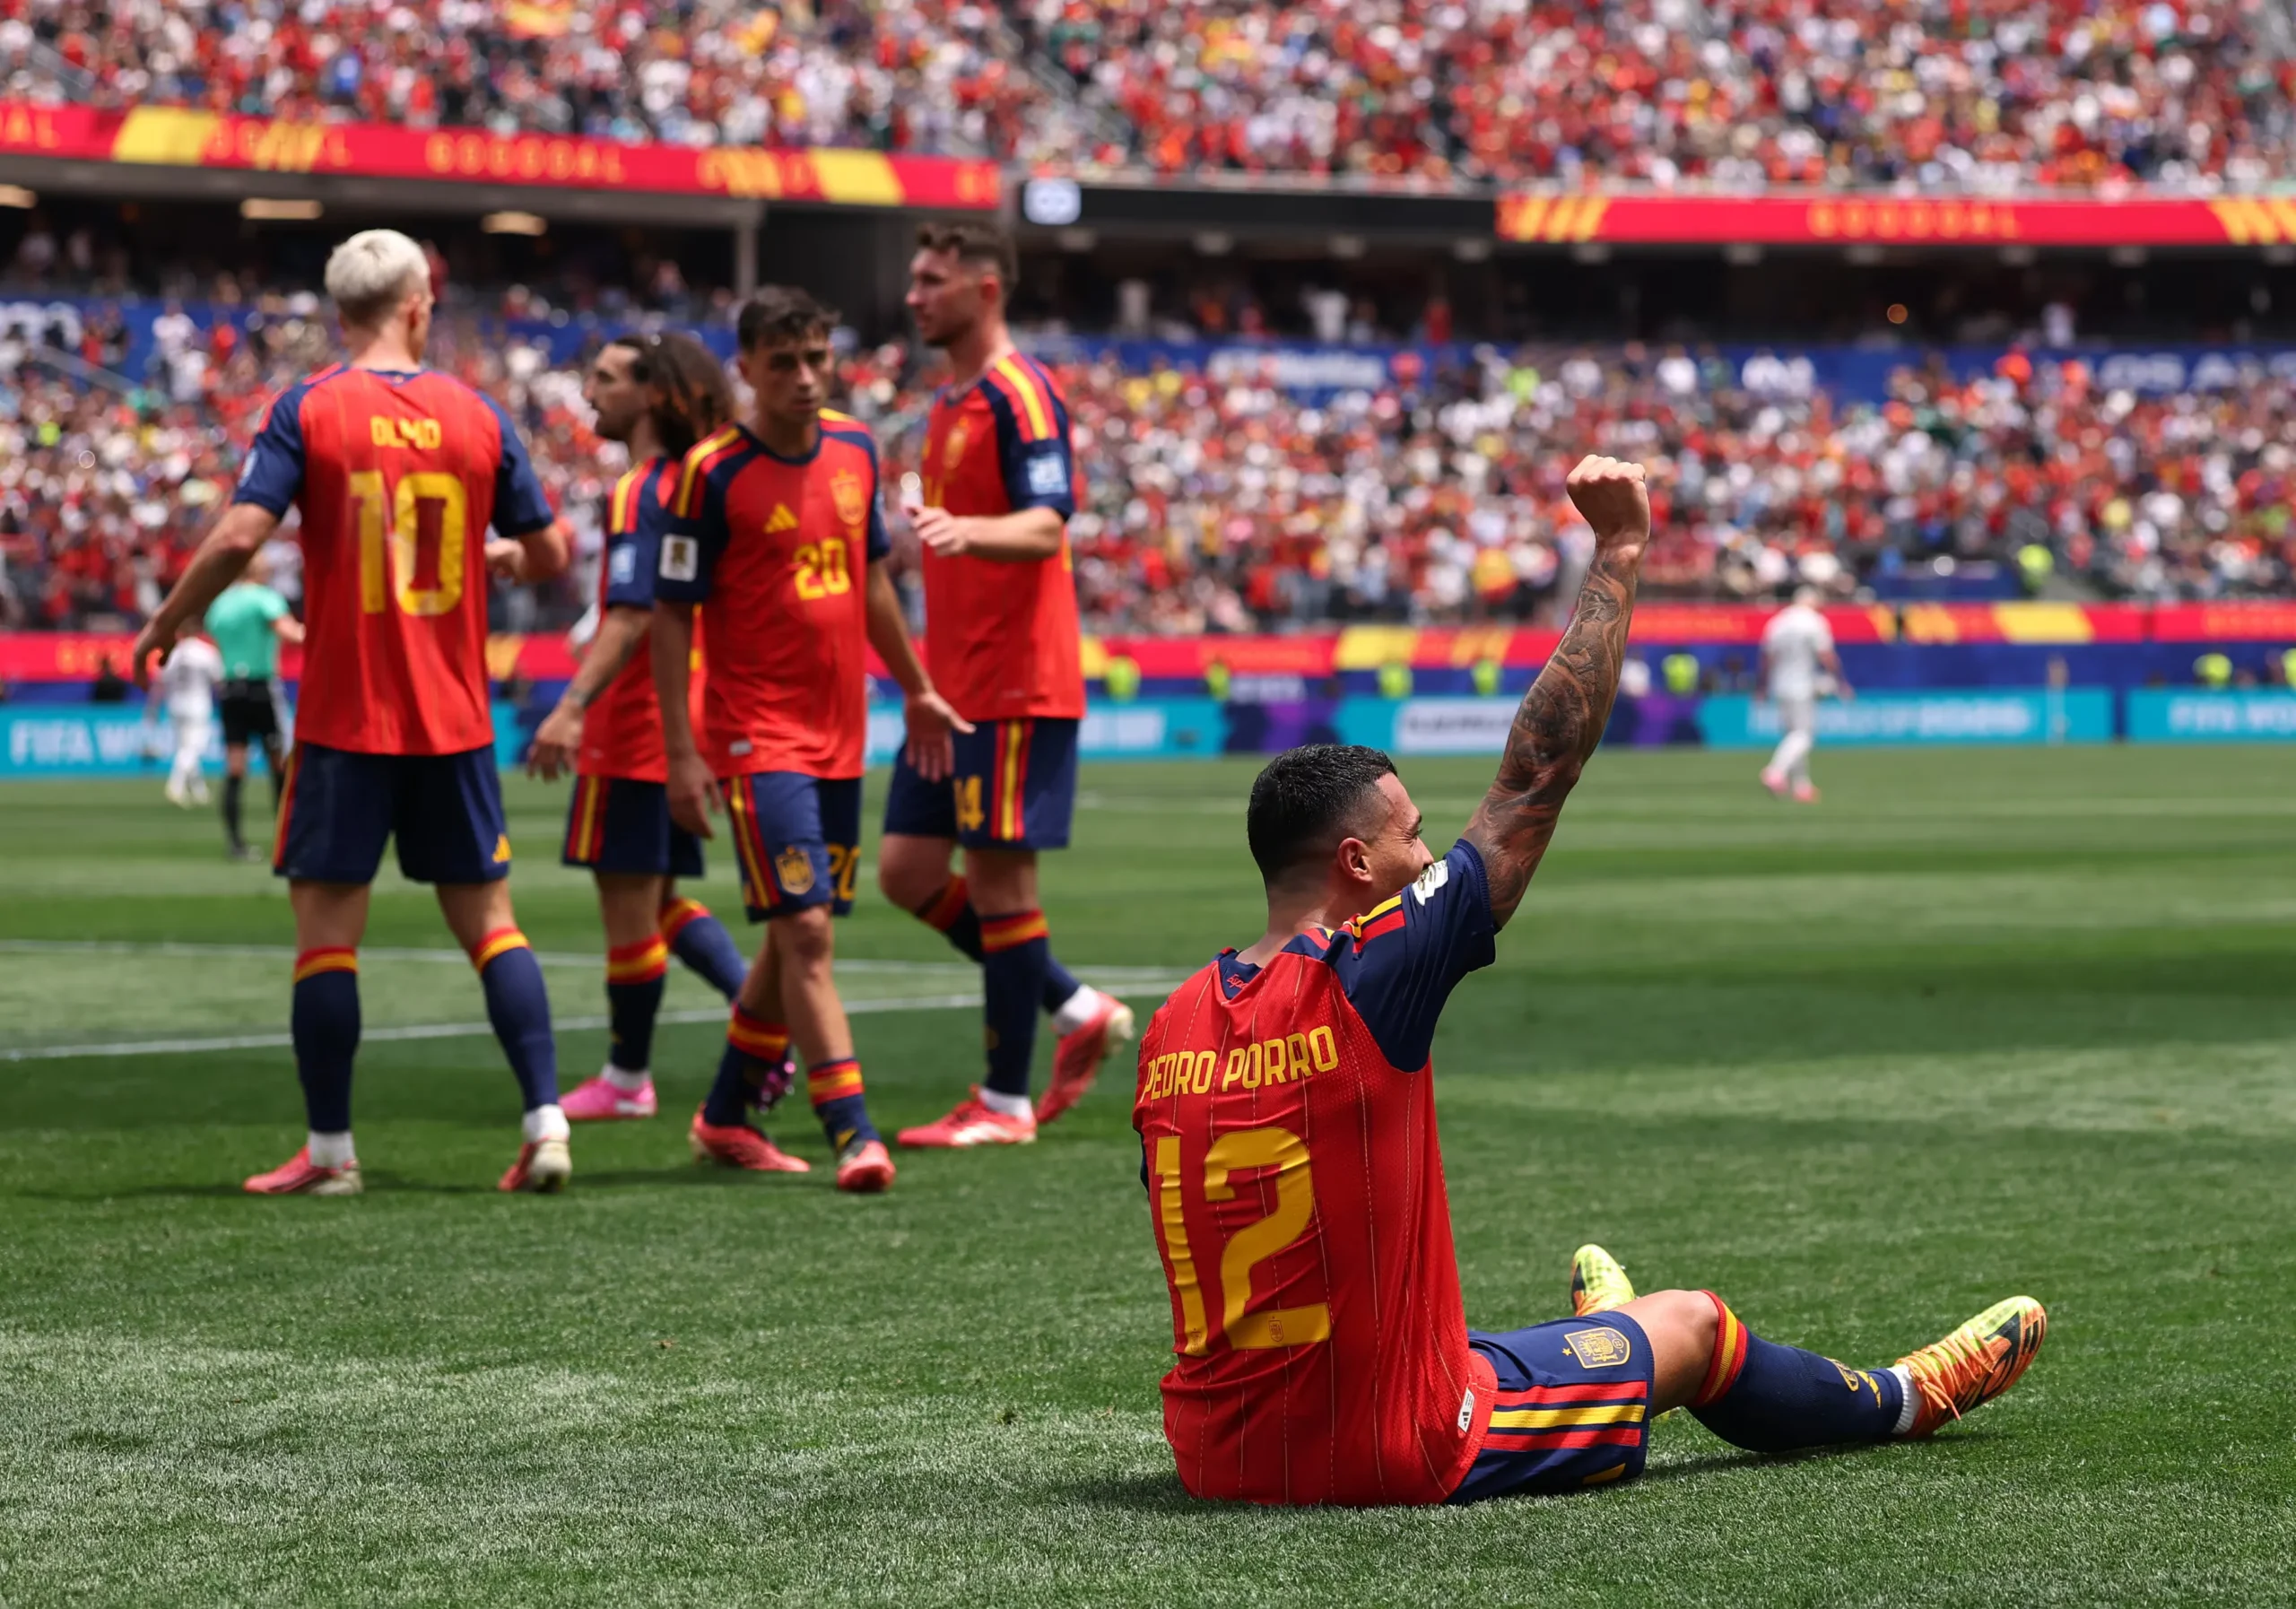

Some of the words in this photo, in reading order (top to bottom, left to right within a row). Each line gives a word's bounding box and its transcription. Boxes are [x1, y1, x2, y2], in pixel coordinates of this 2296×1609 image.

[370, 414, 441, 449] OLMO
[349, 469, 465, 615] 10
[794, 537, 851, 600] 20
[1140, 1050, 1216, 1103] PEDRO
[1222, 1025, 1339, 1092] PORRO
[1155, 1126, 1332, 1356] 12
